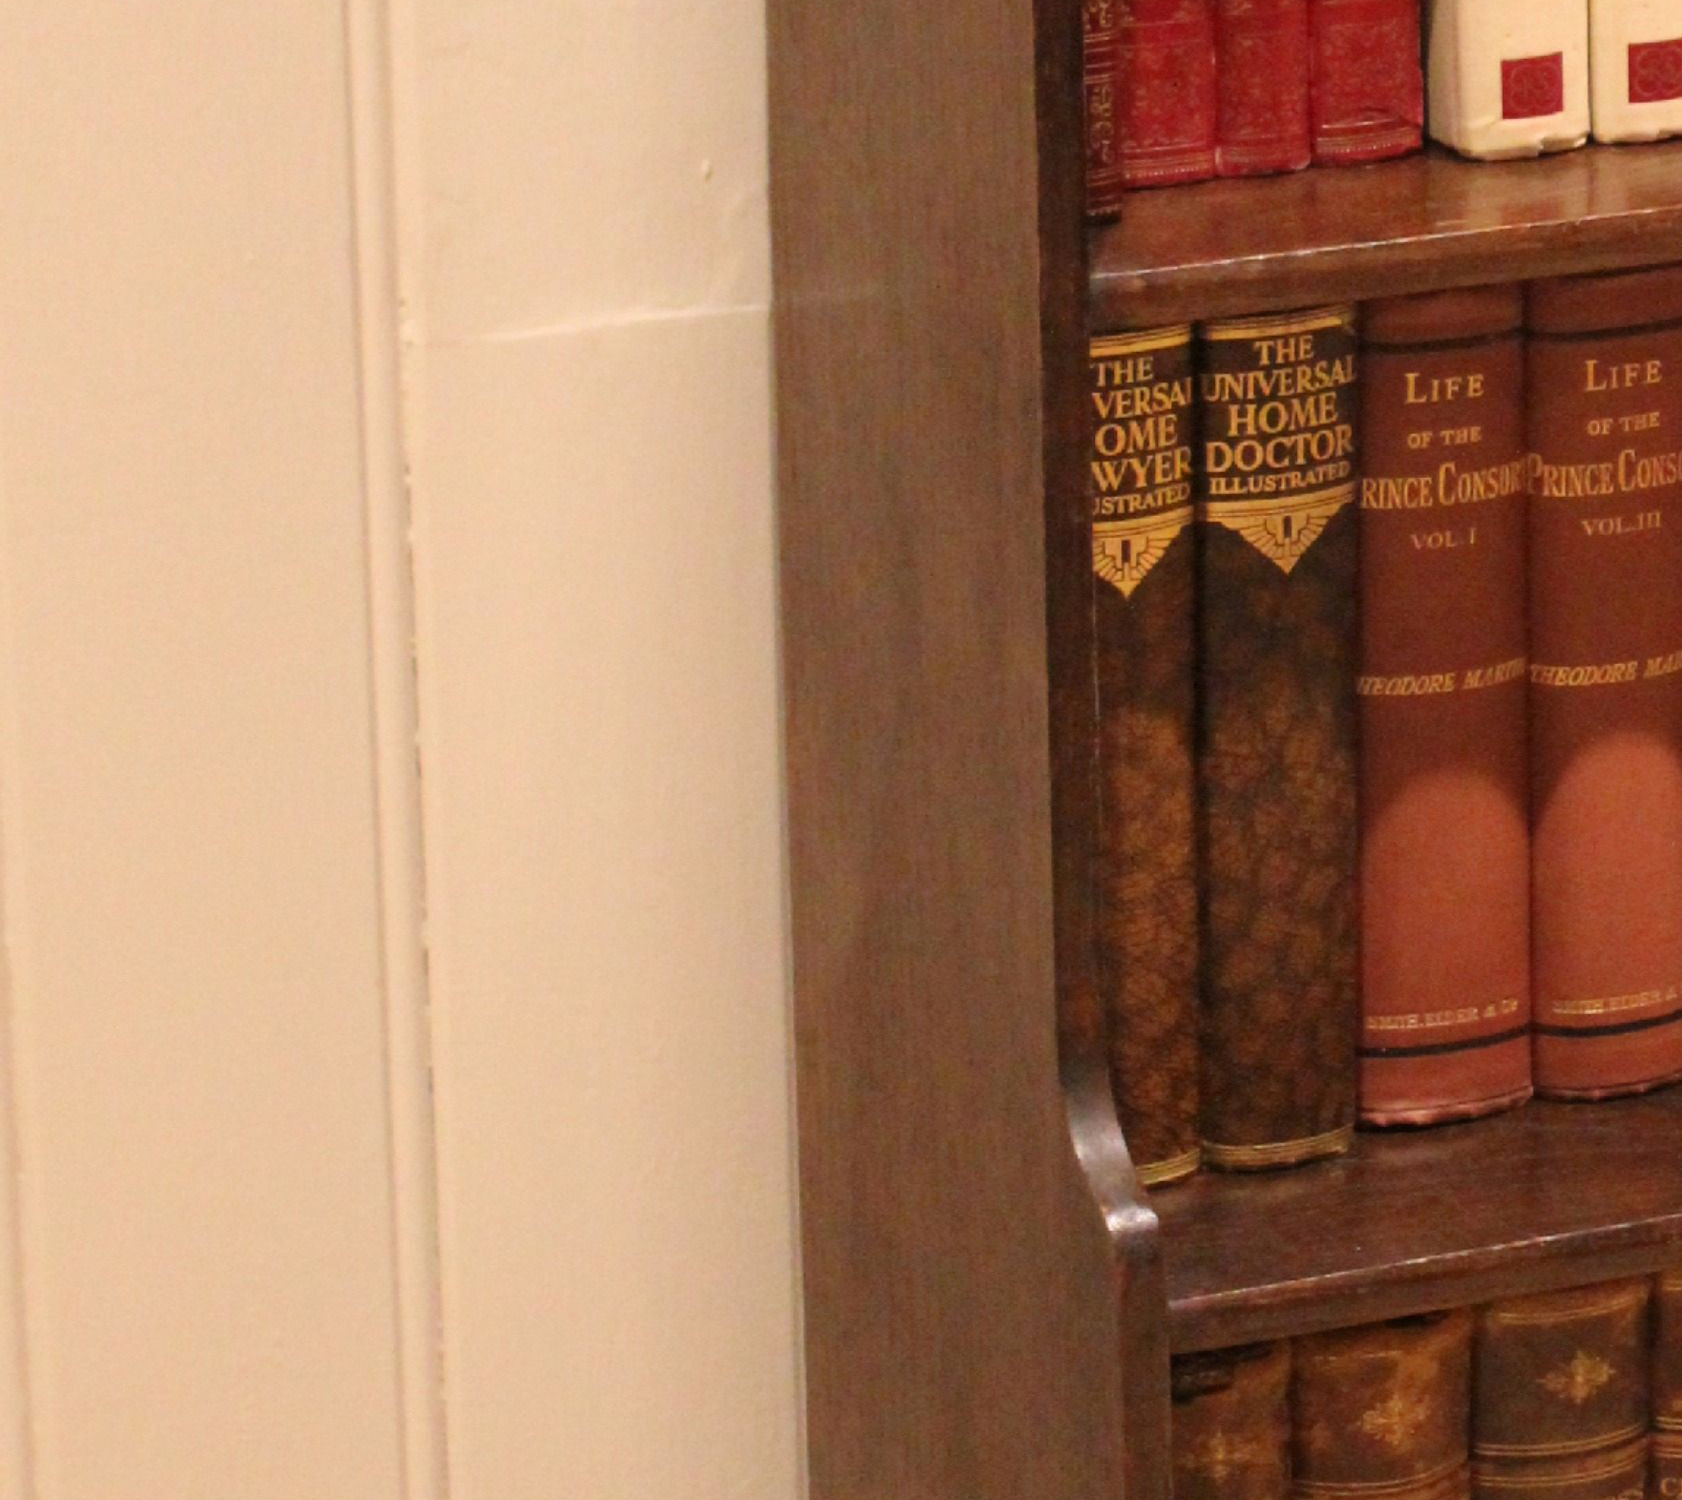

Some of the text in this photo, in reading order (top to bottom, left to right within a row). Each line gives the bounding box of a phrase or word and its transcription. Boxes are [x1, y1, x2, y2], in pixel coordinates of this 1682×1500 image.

[1252, 334, 1315, 366] THE
[1089, 356, 1154, 387] THE
[1202, 354, 1357, 403] UNIVERSAL
[1403, 372, 1486, 405] LIFE
[1583, 359, 1663, 393] LIFE
[1091, 376, 1193, 420] VERSAL
[1227, 390, 1339, 437] HOME
[1094, 413, 1178, 457] OME
[1406, 425, 1482, 450] OF THE
[1586, 411, 1661, 437] OF THE
[1206, 423, 1354, 474] DOCTOR
[1090, 445, 1192, 493] WYER
[1208, 460, 1351, 495] ILLUSTRATED
[1361, 460, 1523, 509] RINCE CONSOR
[1527, 452, 1615, 498] PRINCE
[1093, 482, 1191, 516] STRATED
[1356, 672, 1457, 696] HEODORE
[1529, 660, 1639, 688] THEODORE
